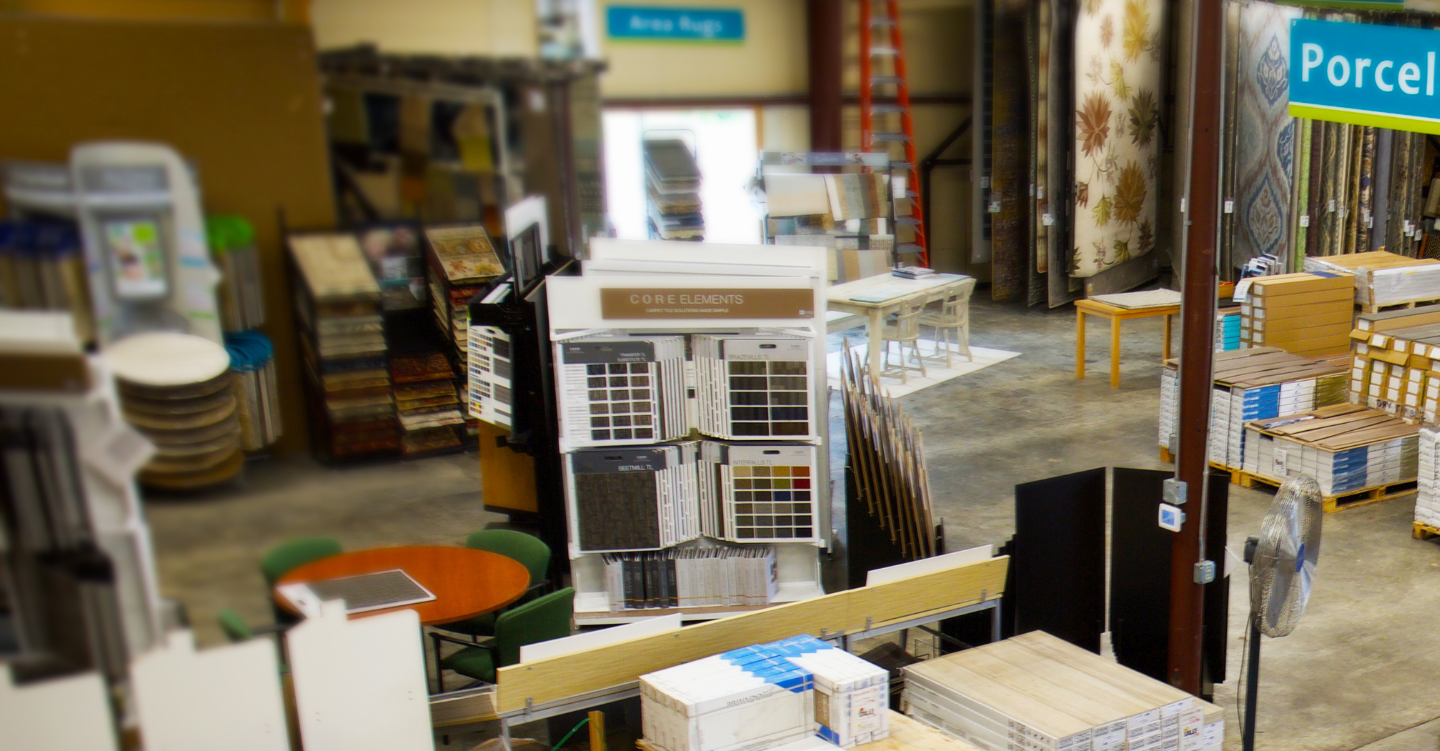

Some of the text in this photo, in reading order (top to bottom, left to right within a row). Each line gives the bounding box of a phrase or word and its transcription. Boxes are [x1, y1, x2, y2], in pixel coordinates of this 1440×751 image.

[629, 15, 722, 38] Area Rugs
[630, 294, 744, 305] CORE ELEMENTS
